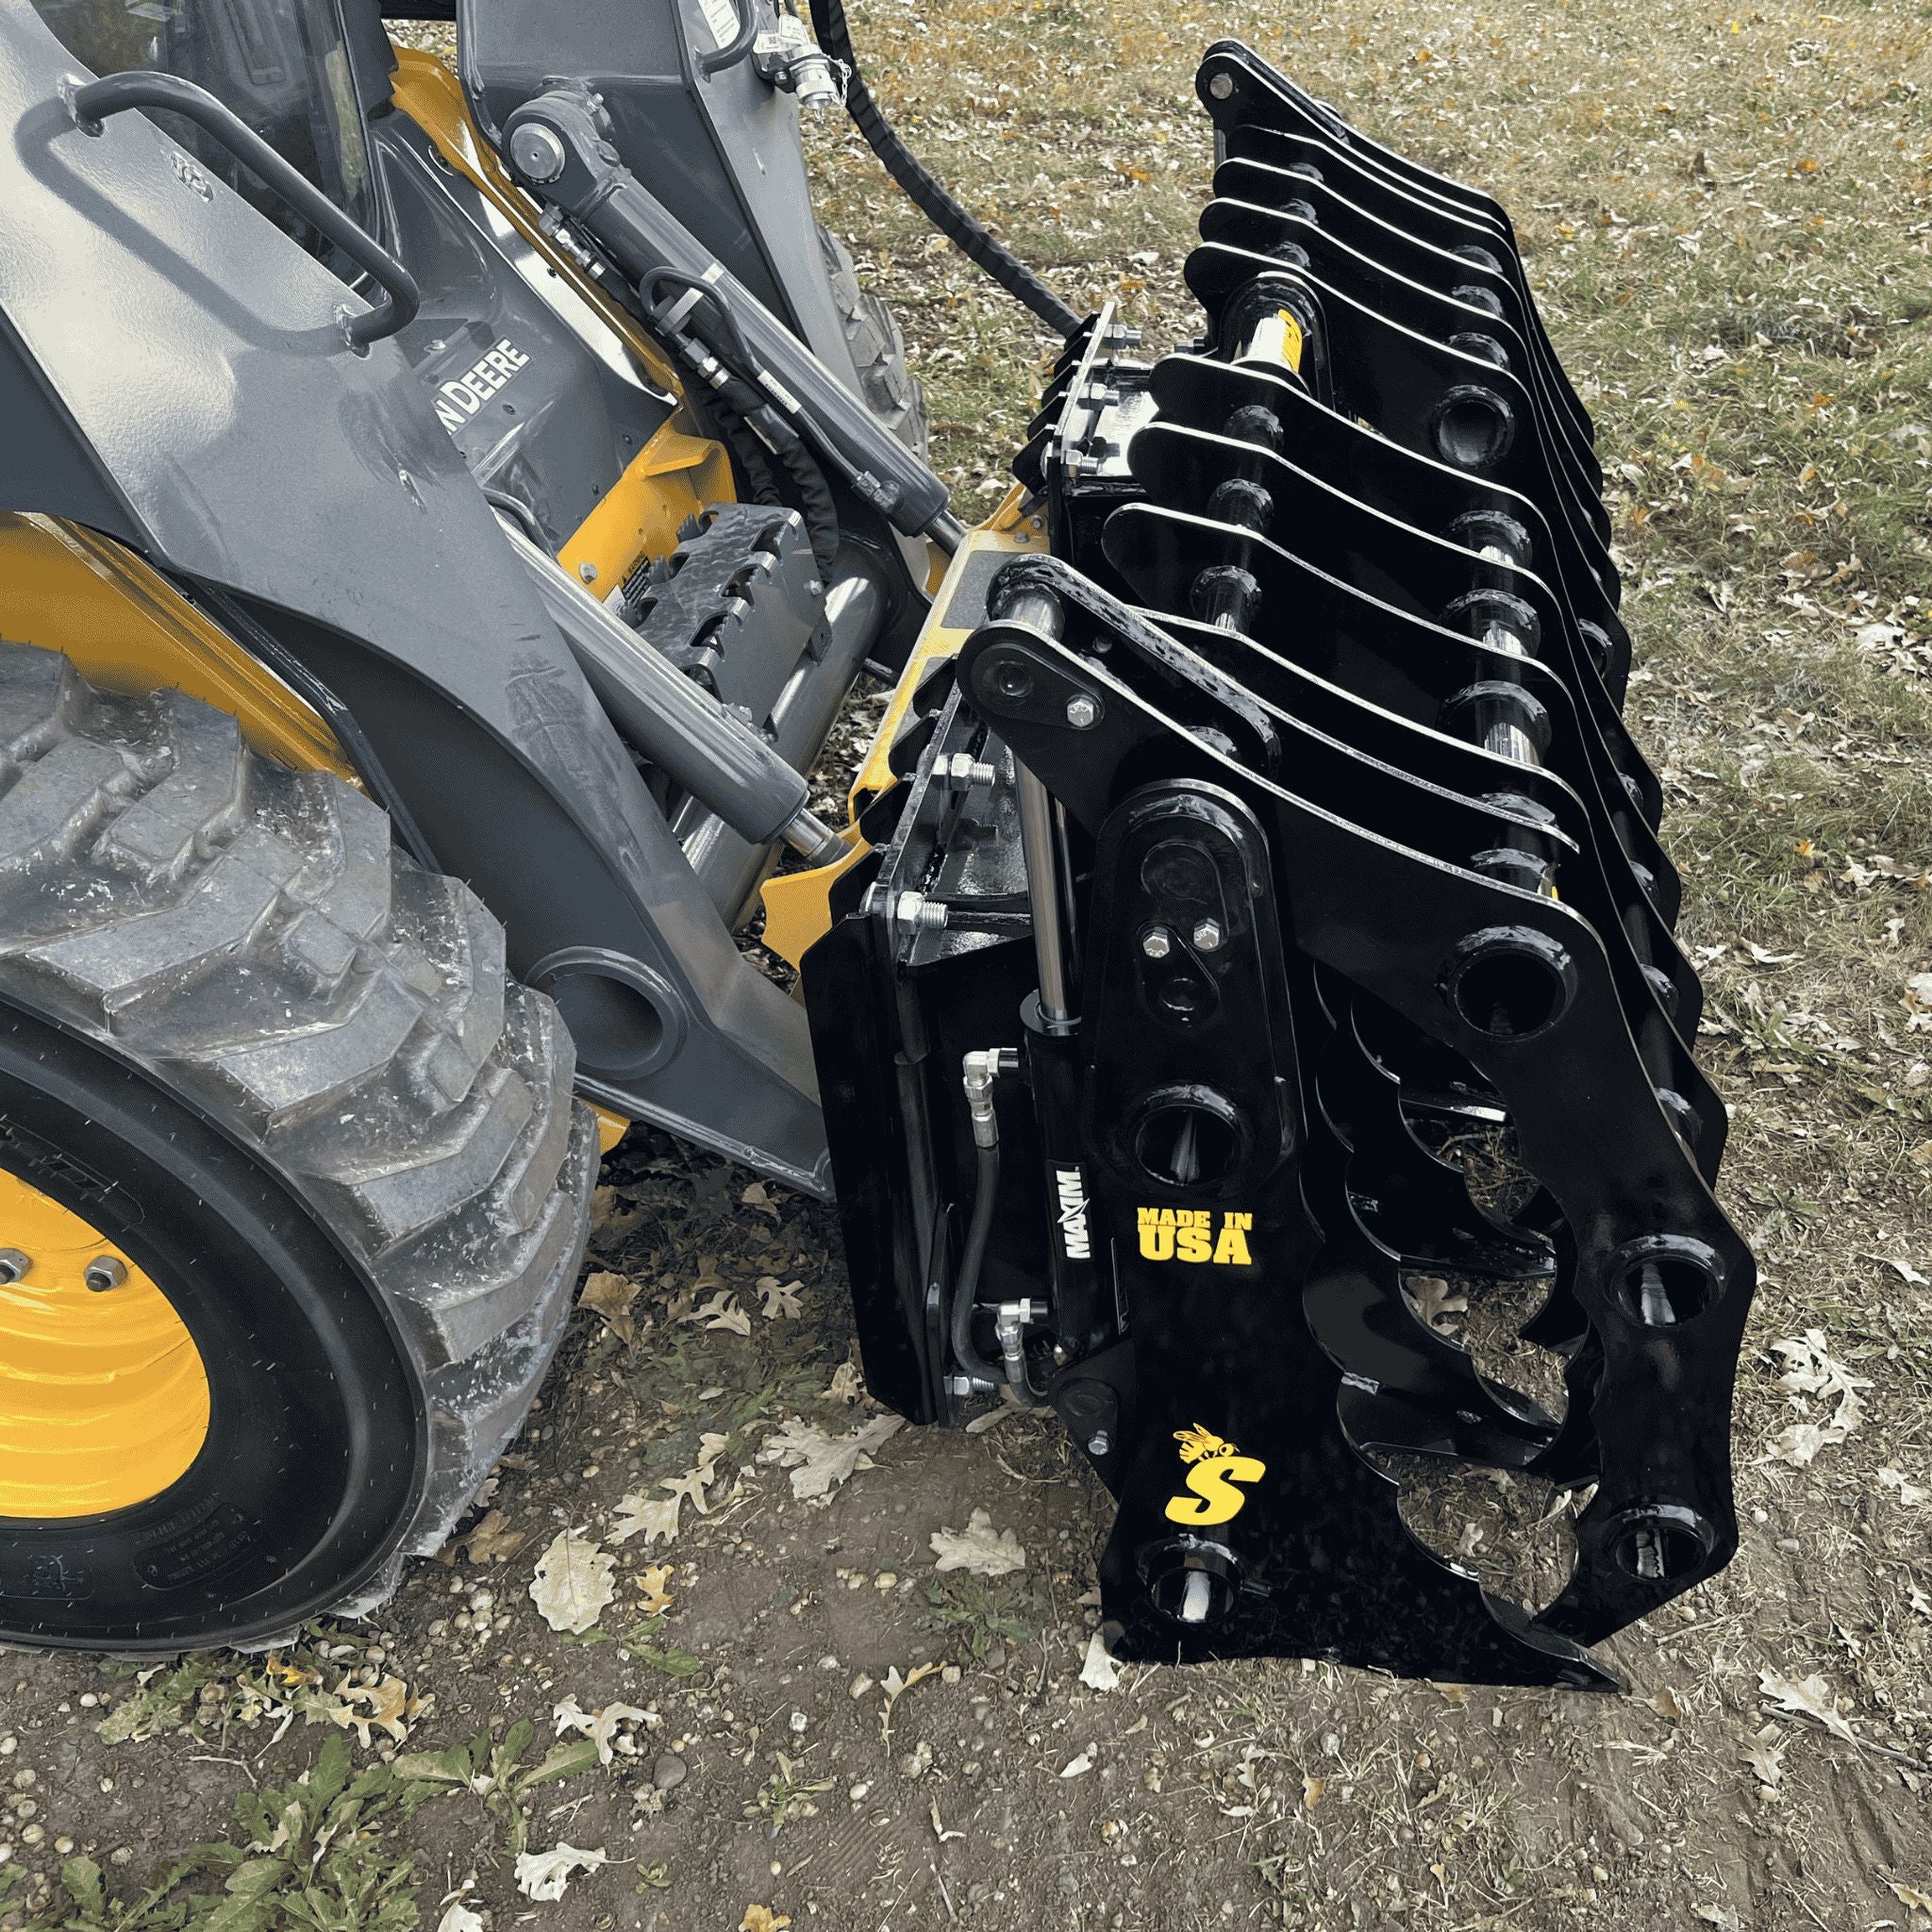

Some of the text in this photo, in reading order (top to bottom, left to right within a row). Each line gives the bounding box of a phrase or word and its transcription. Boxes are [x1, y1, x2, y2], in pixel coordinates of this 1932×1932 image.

[440, 339, 530, 415] DEERE
[1056, 1170, 1091, 1258] MAXIM
[1137, 1207, 1253, 1230] MADE IN
[1137, 1224, 1253, 1265] USA
[1164, 1456, 1267, 1525] S
